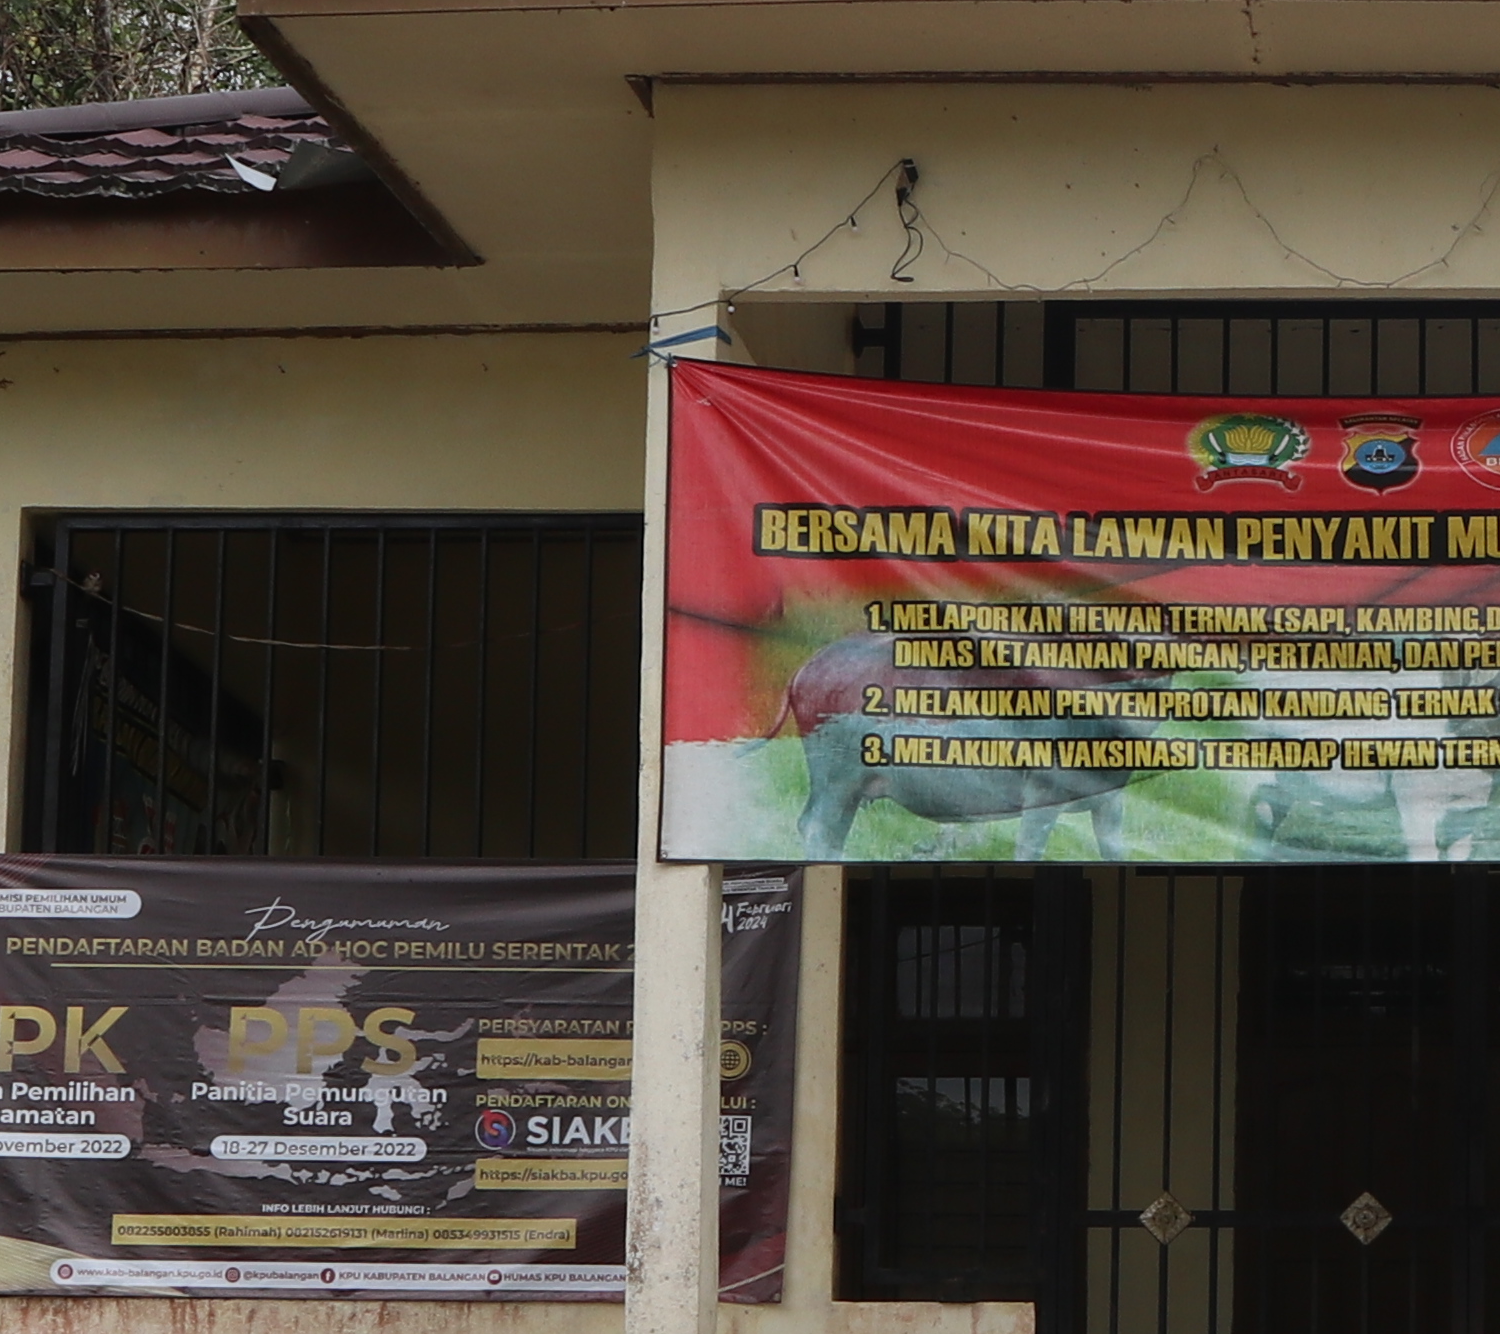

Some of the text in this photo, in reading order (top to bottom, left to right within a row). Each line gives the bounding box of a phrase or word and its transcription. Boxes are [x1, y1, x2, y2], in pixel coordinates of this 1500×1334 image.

[760, 508, 957, 556] BERSAMA
[967, 513, 1061, 557] KITA
[1072, 516, 1225, 559] LAWAN
[1236, 516, 1435, 560] PENYAKIT
[868, 604, 887, 631] 1.
[893, 603, 1063, 633] MELAPORKAN
[1070, 606, 1161, 633] HEWAN
[1167, 607, 1267, 633] TERNAK
[1274, 607, 1351, 635] (SAPI,
[894, 640, 974, 667] DINAS
[981, 640, 1128, 668] KETAHANAN
[1135, 642, 1246, 672] PANGAN,
[1251, 642, 1398, 671] PERTANIAN,
[1405, 641, 1459, 667] DAN
[864, 687, 888, 713] 2.
[895, 689, 1051, 716] MELAKUKAN
[1056, 689, 1258, 717] PENYEMPROTAN
[1264, 689, 1391, 717] KANDANG
[1395, 688, 1496, 715] TERNAK
[863, 737, 887, 764] 3.
[894, 738, 1052, 766] MELAKUKAN
[1058, 740, 1195, 767] VAKSINASI
[1202, 740, 1338, 767] TERHADAP
[1343, 740, 1435, 766] HEWAN
[25, 894, 88, 903] PEMILIHAN
[90, 895, 127, 904] UMUM
[54, 905, 118, 914] BALANGAN
[244, 896, 450, 944] Pengumuman
[736, 916, 768, 931] 2024
[6, 937, 188, 957] PENDAFTARAN
[197, 939, 284, 958] BADAN
[291, 940, 327, 958] AD
[335, 940, 388, 958] HOC
[394, 941, 485, 960] PEMILU
[492, 942, 620, 962] SERENTAK
[478, 1019, 620, 1035] PERSYARATAN
[227, 1006, 417, 1076] PPS
[11, 1081, 135, 1101] Pemilihan
[191, 1081, 448, 1107] Panitia Pemungutan
[476, 1095, 601, 1108] PENDAFTARAN
[283, 1106, 353, 1126] Suara
[81, 1139, 123, 1154] 2022
[222, 1140, 416, 1156] 18-27 Desember 2022
[262, 1204, 289, 1212] INFO
[292, 1204, 325, 1213] LEBIH
[327, 1205, 370, 1214] LANJUT
[372, 1205, 425, 1215] HUBUNGI
[214, 1226, 282, 1239] (Rahimah)
[371, 1228, 429, 1241] (Marlina)
[524, 1229, 570, 1242] (Endra)
[243, 1270, 319, 1282] @kpubalangan
[339, 1272, 361, 1280] KPU
[363, 1272, 426, 1281] KABUPATEN
[429, 1272, 486, 1282] BALANGAN
[504, 1273, 542, 1282] HUMAS
[544, 1273, 566, 1282] KPU
